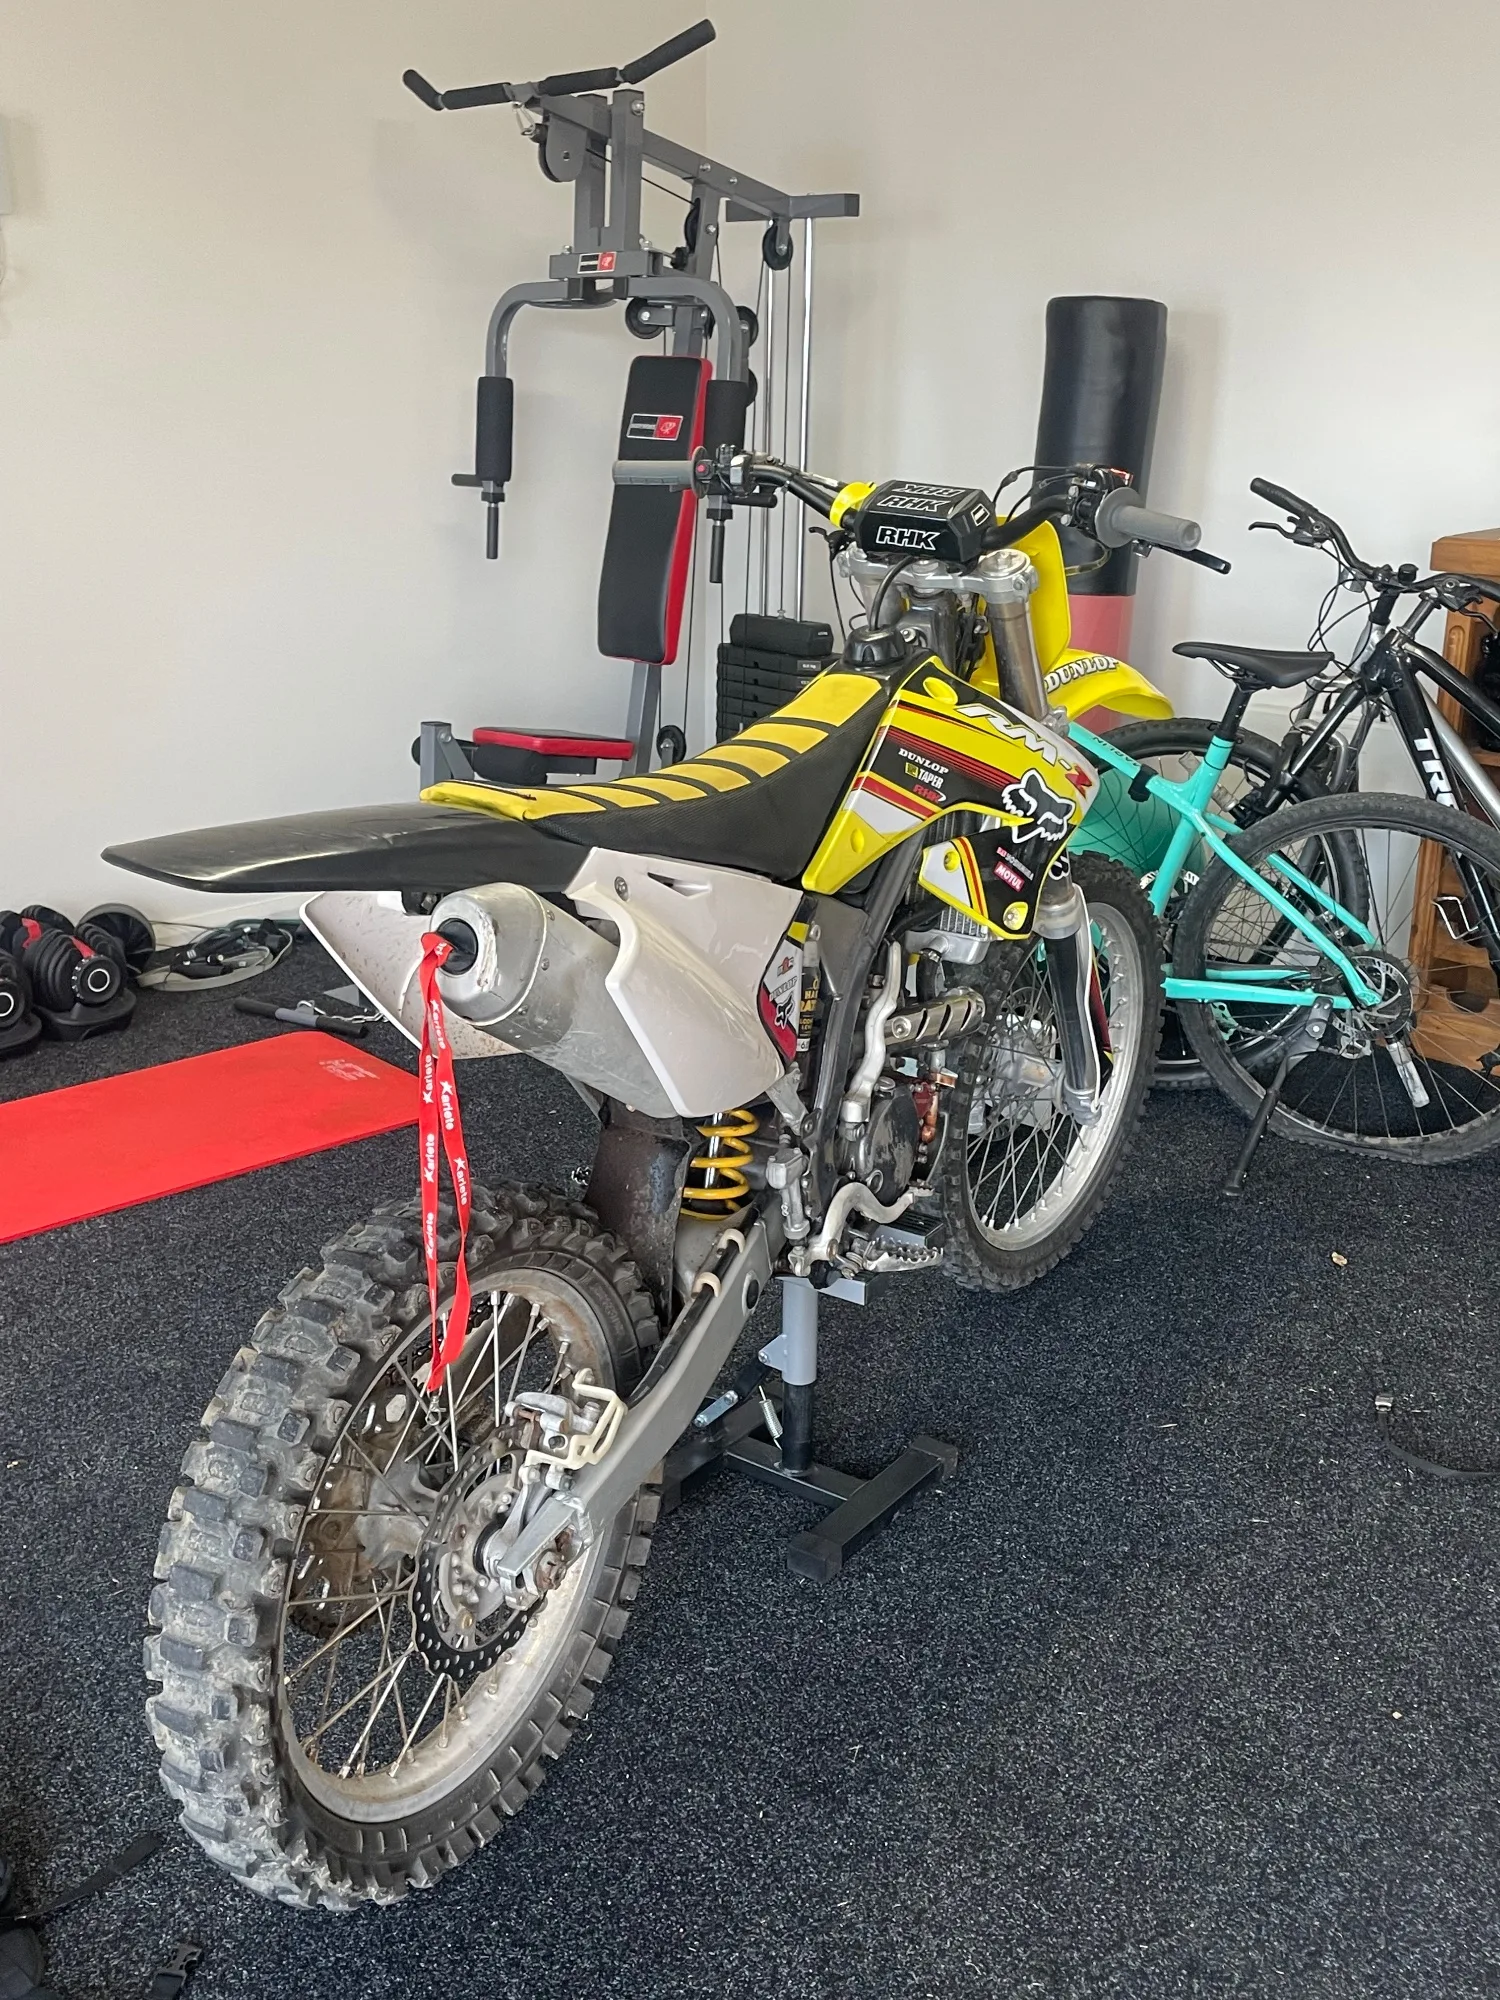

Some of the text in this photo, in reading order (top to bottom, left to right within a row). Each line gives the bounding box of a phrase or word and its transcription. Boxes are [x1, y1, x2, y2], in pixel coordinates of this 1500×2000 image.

[877, 495, 951, 512] RHK
[876, 526, 940, 550] RHK
[1043, 656, 1120, 694] DUNLOP
[898, 747, 949, 774] DUNLOP
[918, 768, 944, 789] TAPER
[995, 864, 1022, 890] MOTUL
